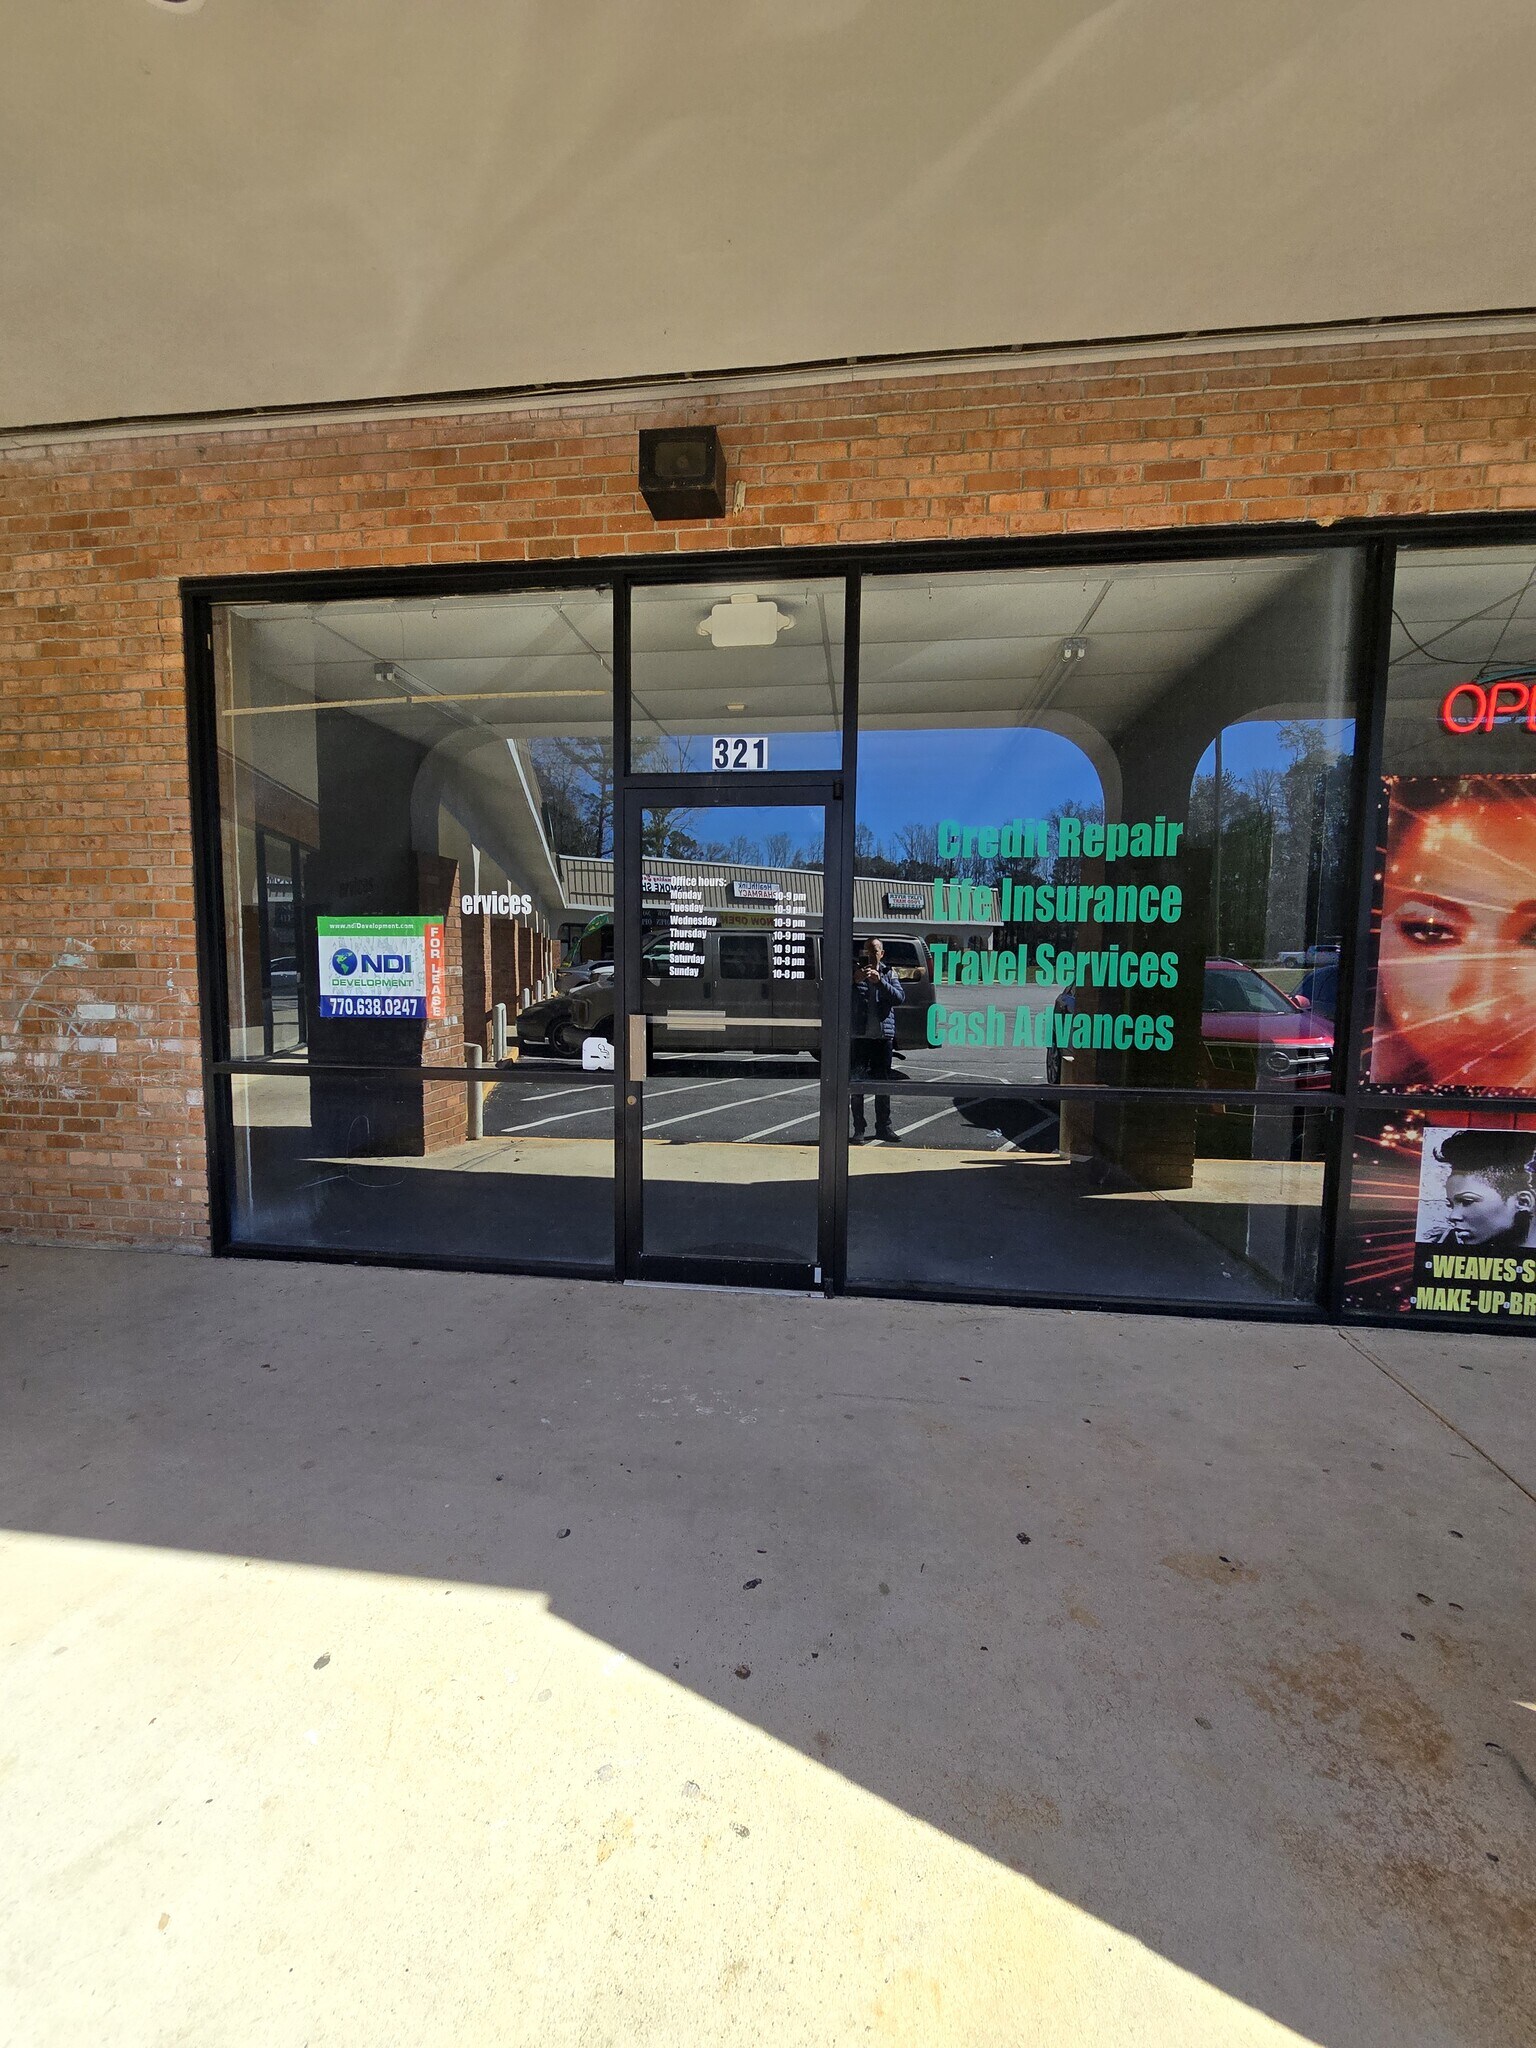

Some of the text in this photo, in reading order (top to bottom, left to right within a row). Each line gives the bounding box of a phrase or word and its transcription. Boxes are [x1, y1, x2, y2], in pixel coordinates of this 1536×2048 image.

[1443, 682, 1536, 733] OP
[715, 739, 764, 768] 321
[937, 816, 1184, 861] Credit Repair
[671, 876, 727, 887] Office hours:
[461, 890, 532, 915] ervices
[671, 890, 806, 901] Monday 10-9 pm
[933, 877, 1183, 923] Life Insurance
[670, 903, 806, 915] Tuesday 10-9 pm
[670, 916, 717, 926] Wednesday
[774, 918, 791, 927] 10-9
[792, 919, 806, 928] pm
[670, 928, 806, 941] Thursday 10-9 pm
[670, 941, 695, 952] Friday
[791, 945, 805, 954] pm
[361, 954, 412, 973] NDI
[669, 954, 805, 966] Saturday 10-8 pm
[930, 943, 1179, 988] Travel Services
[430, 927, 441, 1016] FOR LEASE
[669, 966, 805, 979] Sunday 10-8 pm
[332, 979, 414, 987] DEVELOPMENT
[330, 998, 417, 1016] 770.638.0247
[927, 1003, 1175, 1051] Cash Advances
[1433, 1255, 1517, 1282] WEAVES
[1416, 1287, 1505, 1314] MAKE-UP
